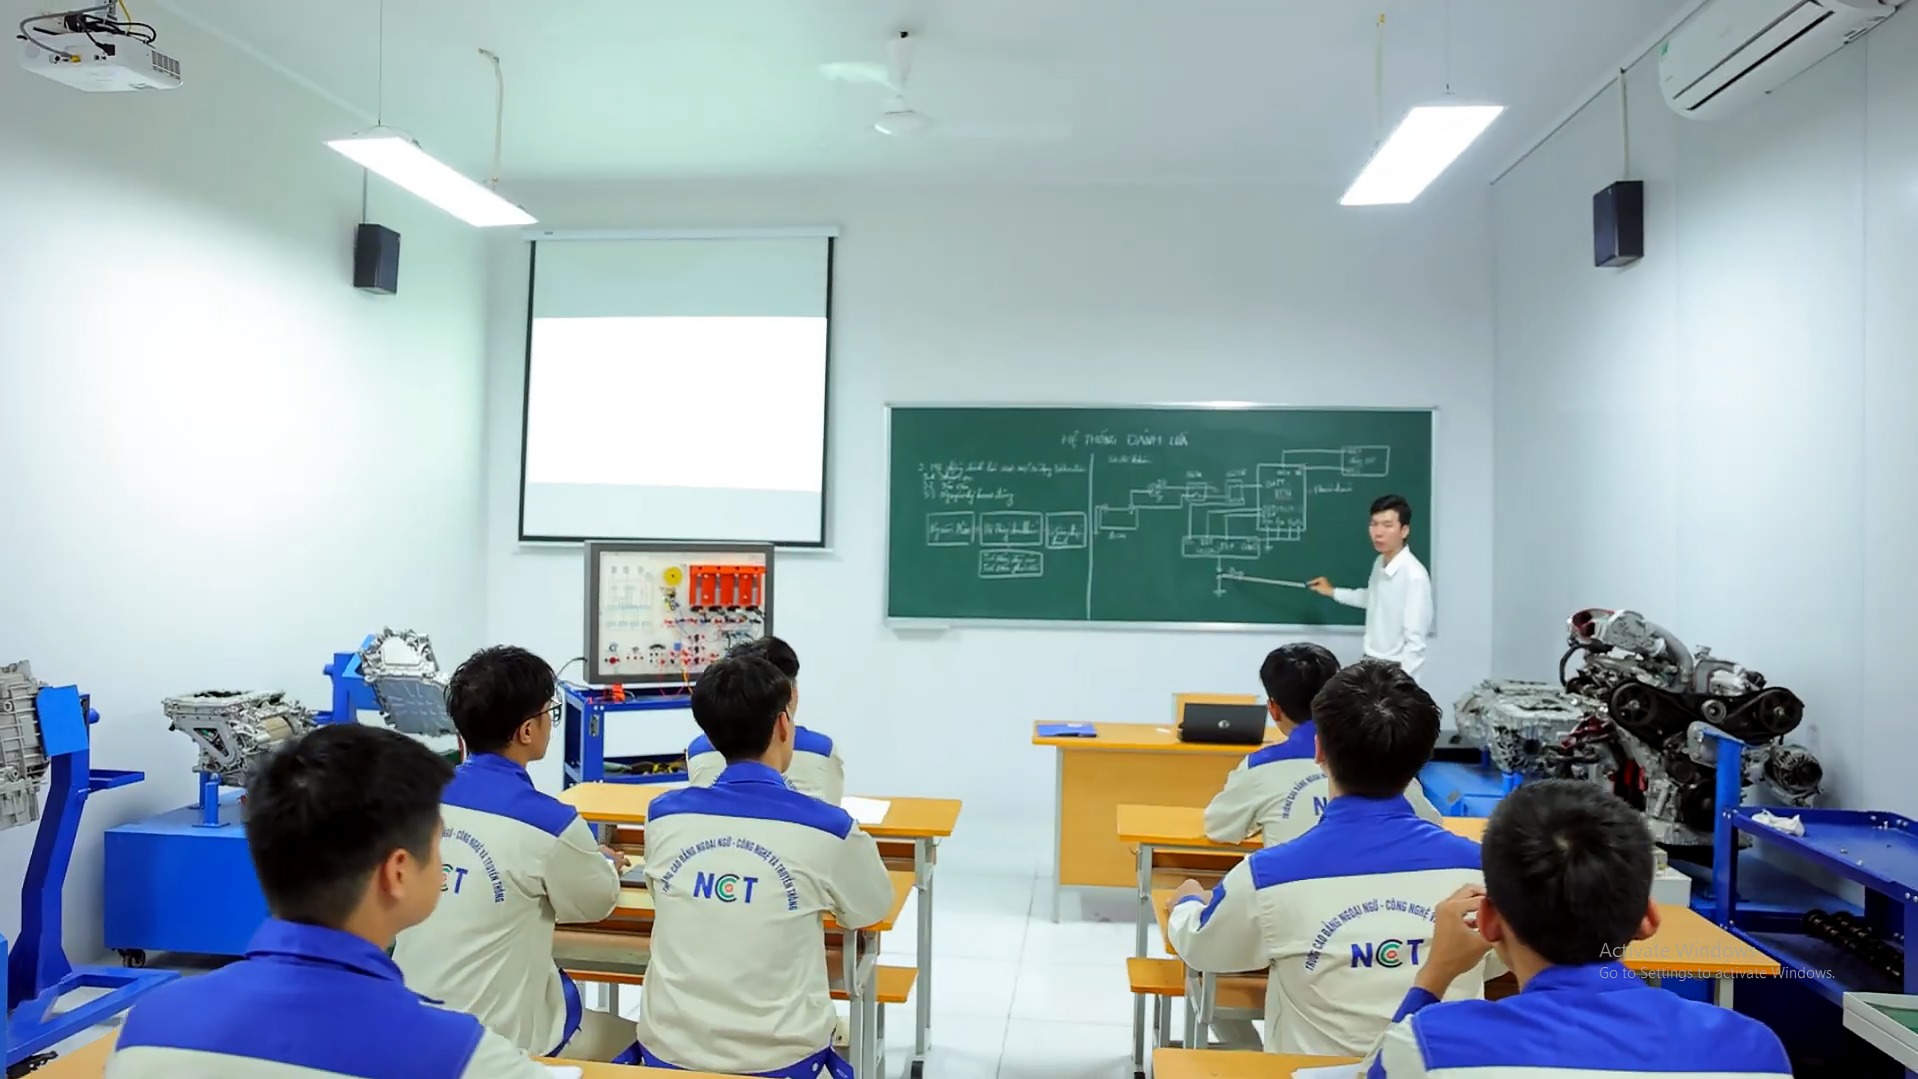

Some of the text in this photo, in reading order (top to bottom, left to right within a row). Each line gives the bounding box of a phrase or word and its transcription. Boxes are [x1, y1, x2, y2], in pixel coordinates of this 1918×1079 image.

[736, 838, 755, 852] CÔNG
[693, 871, 758, 903] NCT
[1312, 934, 1328, 950] CAO
[1338, 905, 1363, 923] NGOẠI
[1385, 897, 1408, 912] CÔNG
[1408, 903, 1431, 921] NGHỆ
[1351, 939, 1424, 969] NCT
